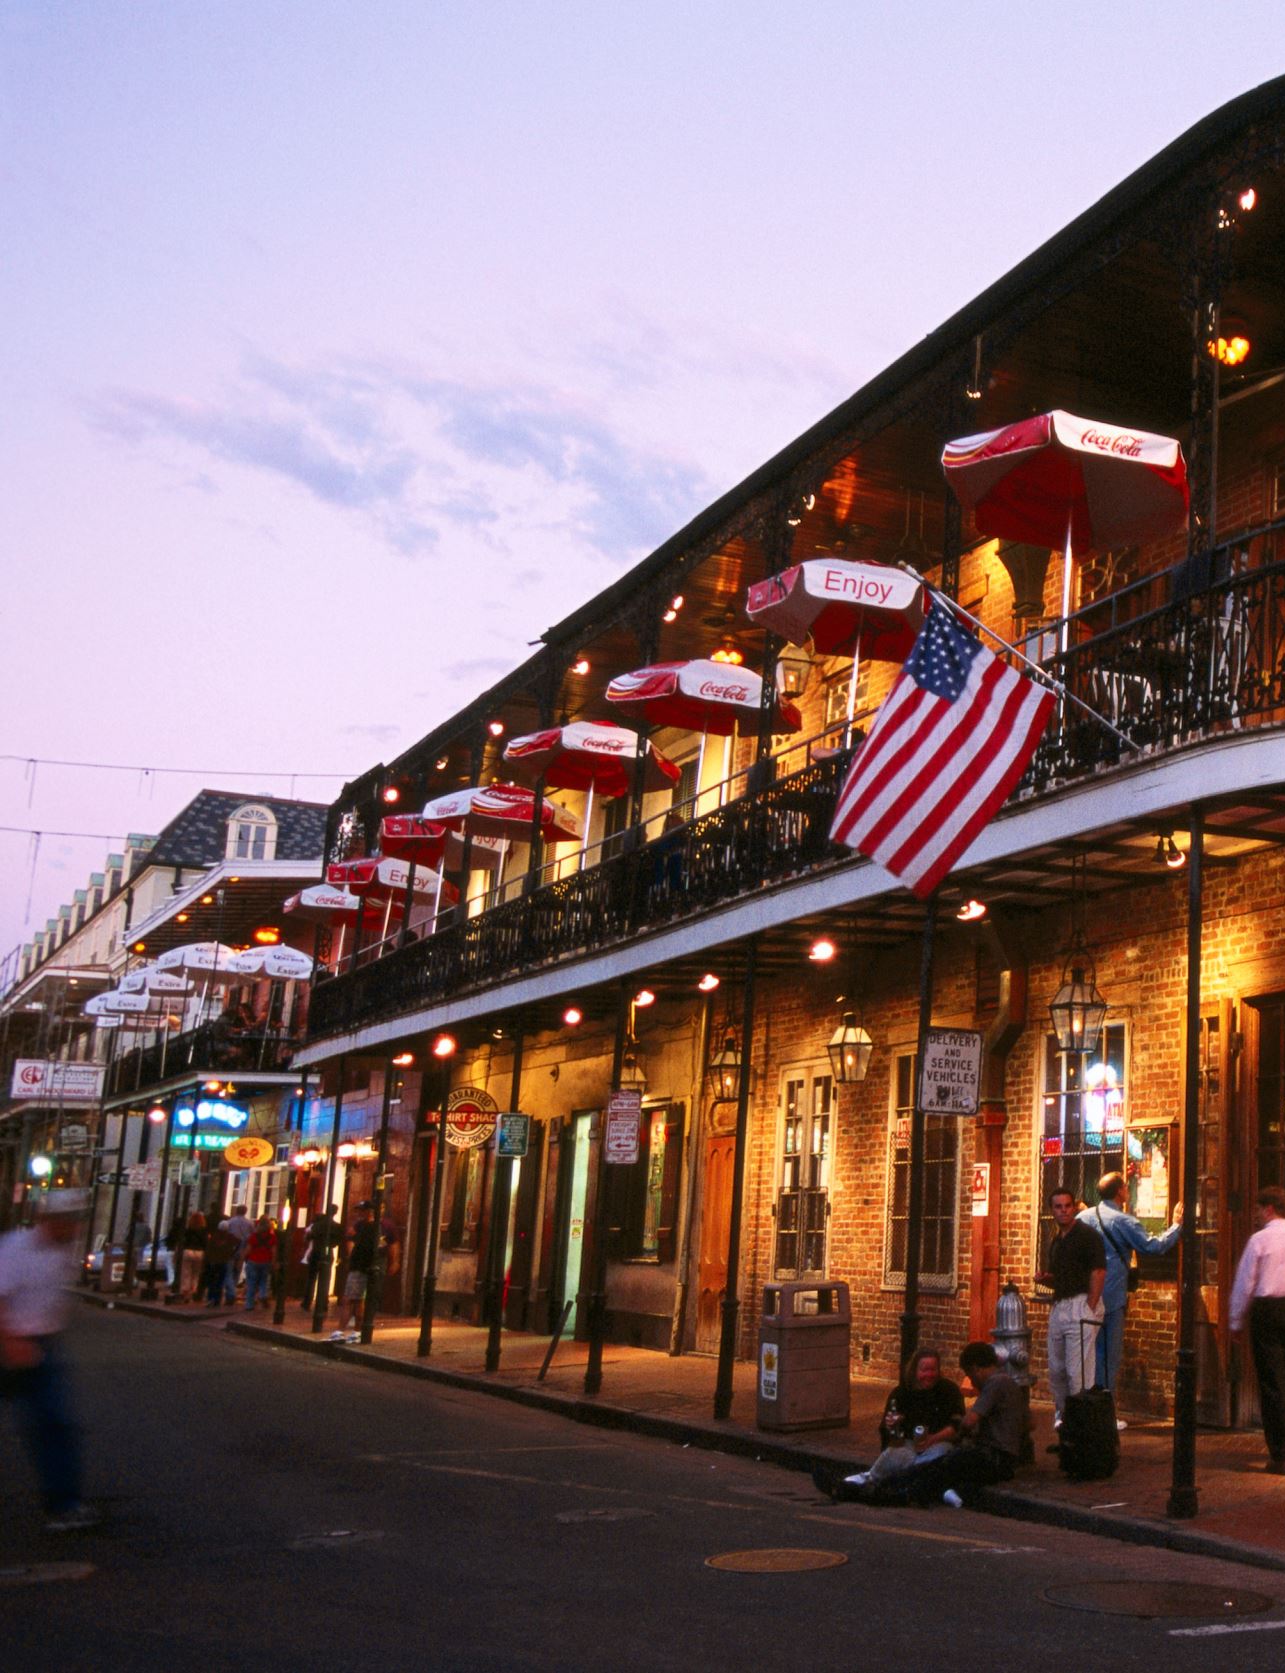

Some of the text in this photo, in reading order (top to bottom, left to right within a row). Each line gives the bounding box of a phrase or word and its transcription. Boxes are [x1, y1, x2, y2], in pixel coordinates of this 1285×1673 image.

[824, 569, 894, 605] Enjoy
[389, 868, 430, 891] Enoy
[928, 1034, 978, 1048] DELIVERY
[944, 1048, 962, 1057] AND
[931, 1058, 974, 1071] SERVICE
[926, 1070, 977, 1085] VEHICLES
